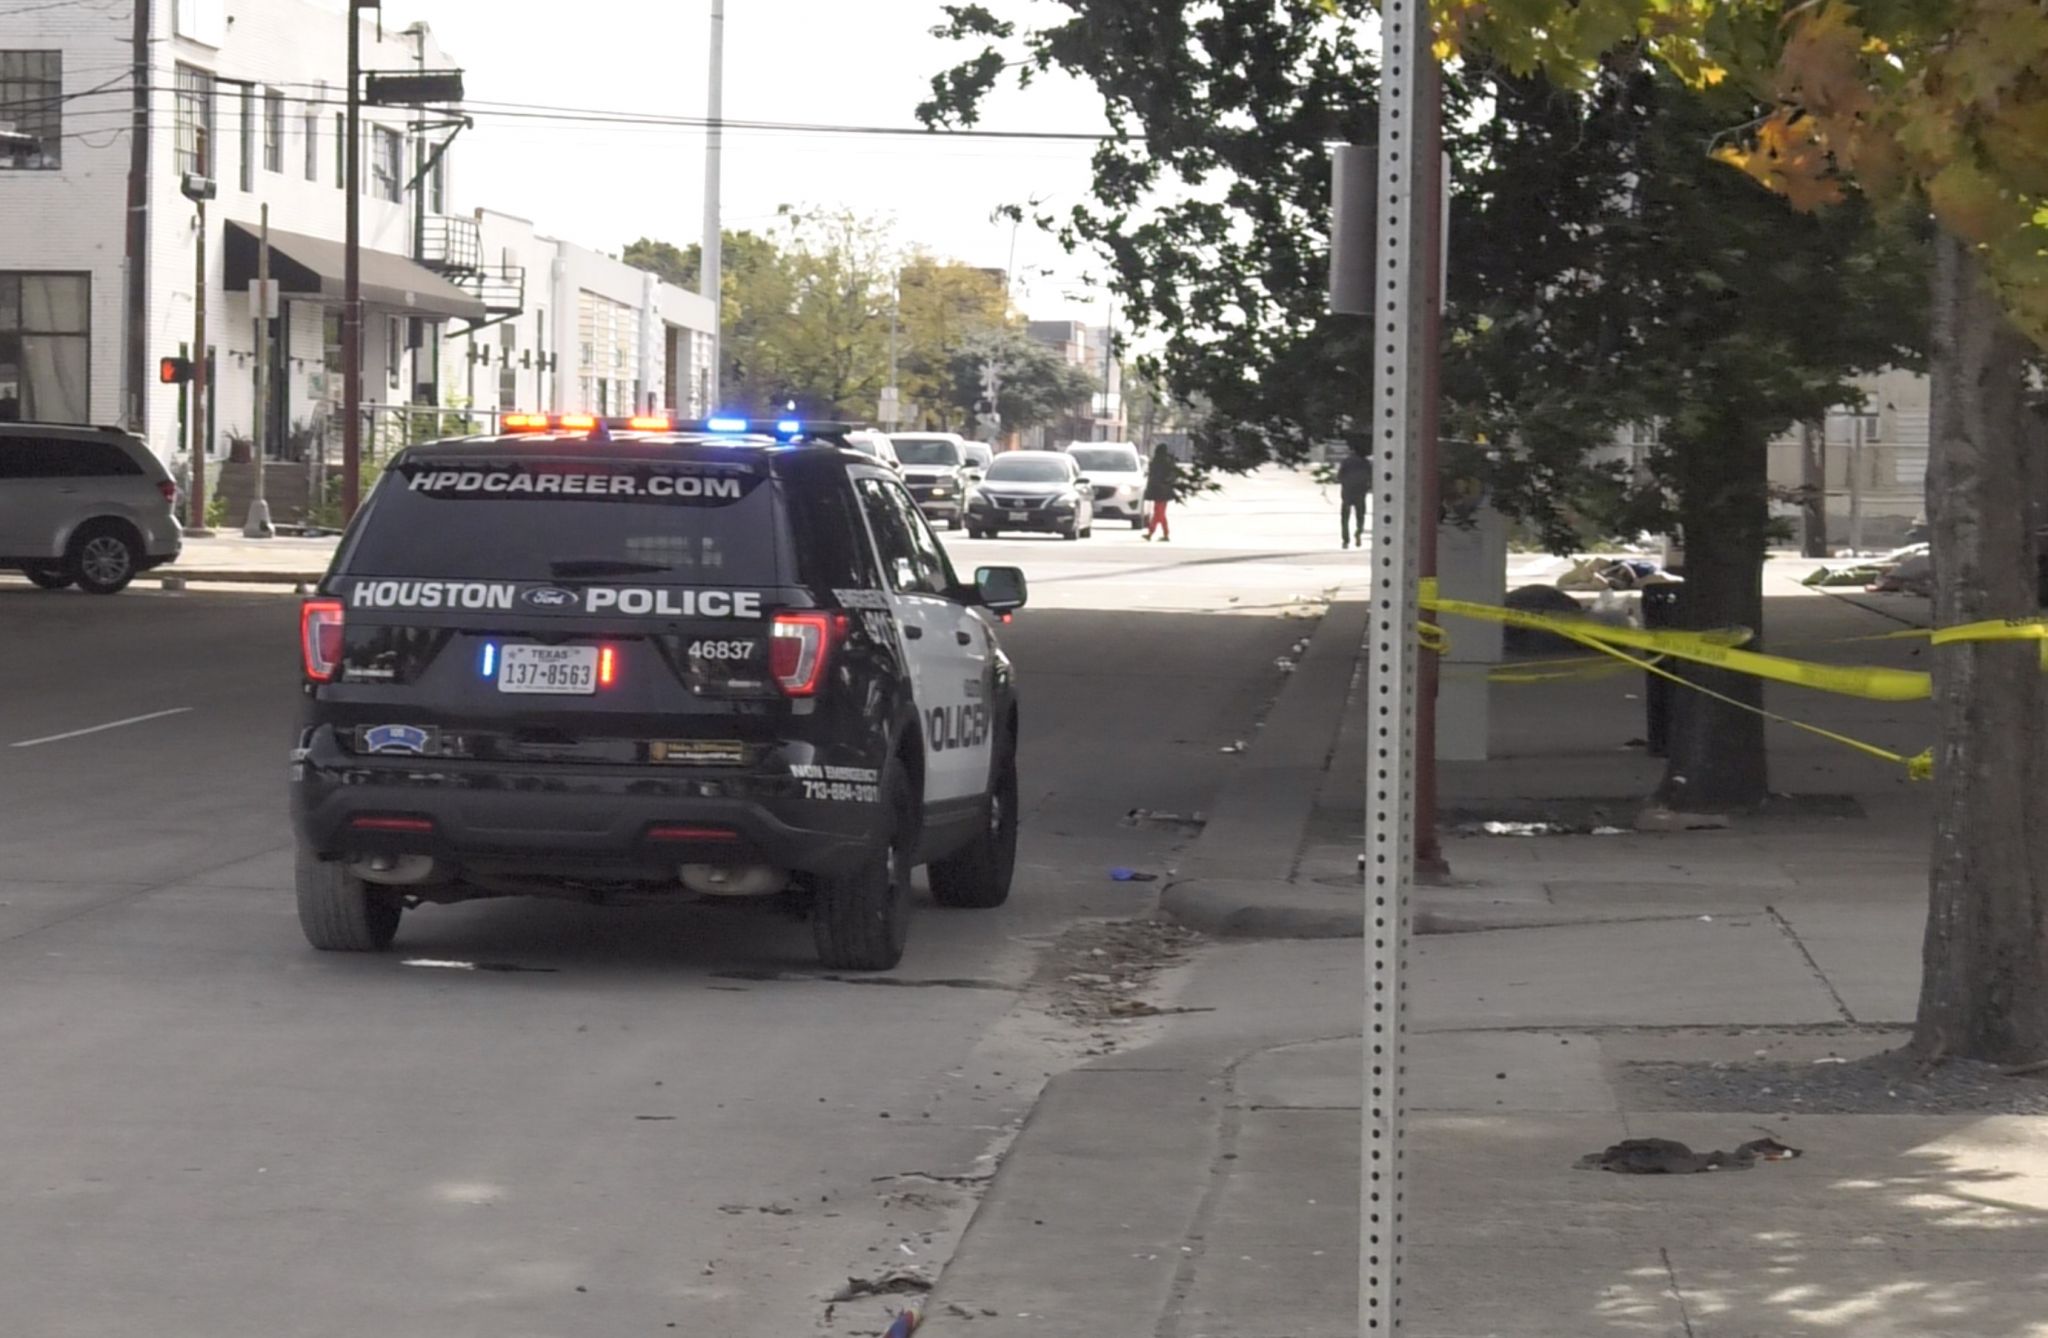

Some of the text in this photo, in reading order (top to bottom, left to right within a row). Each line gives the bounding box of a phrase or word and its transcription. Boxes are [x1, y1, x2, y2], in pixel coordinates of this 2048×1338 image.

[408, 472, 741, 498] HPDCAREER.COM
[353, 581, 515, 609] HOUSTON
[585, 587, 762, 618] POLICE
[531, 649, 568, 659] TEXAS
[688, 641, 754, 659] 46837
